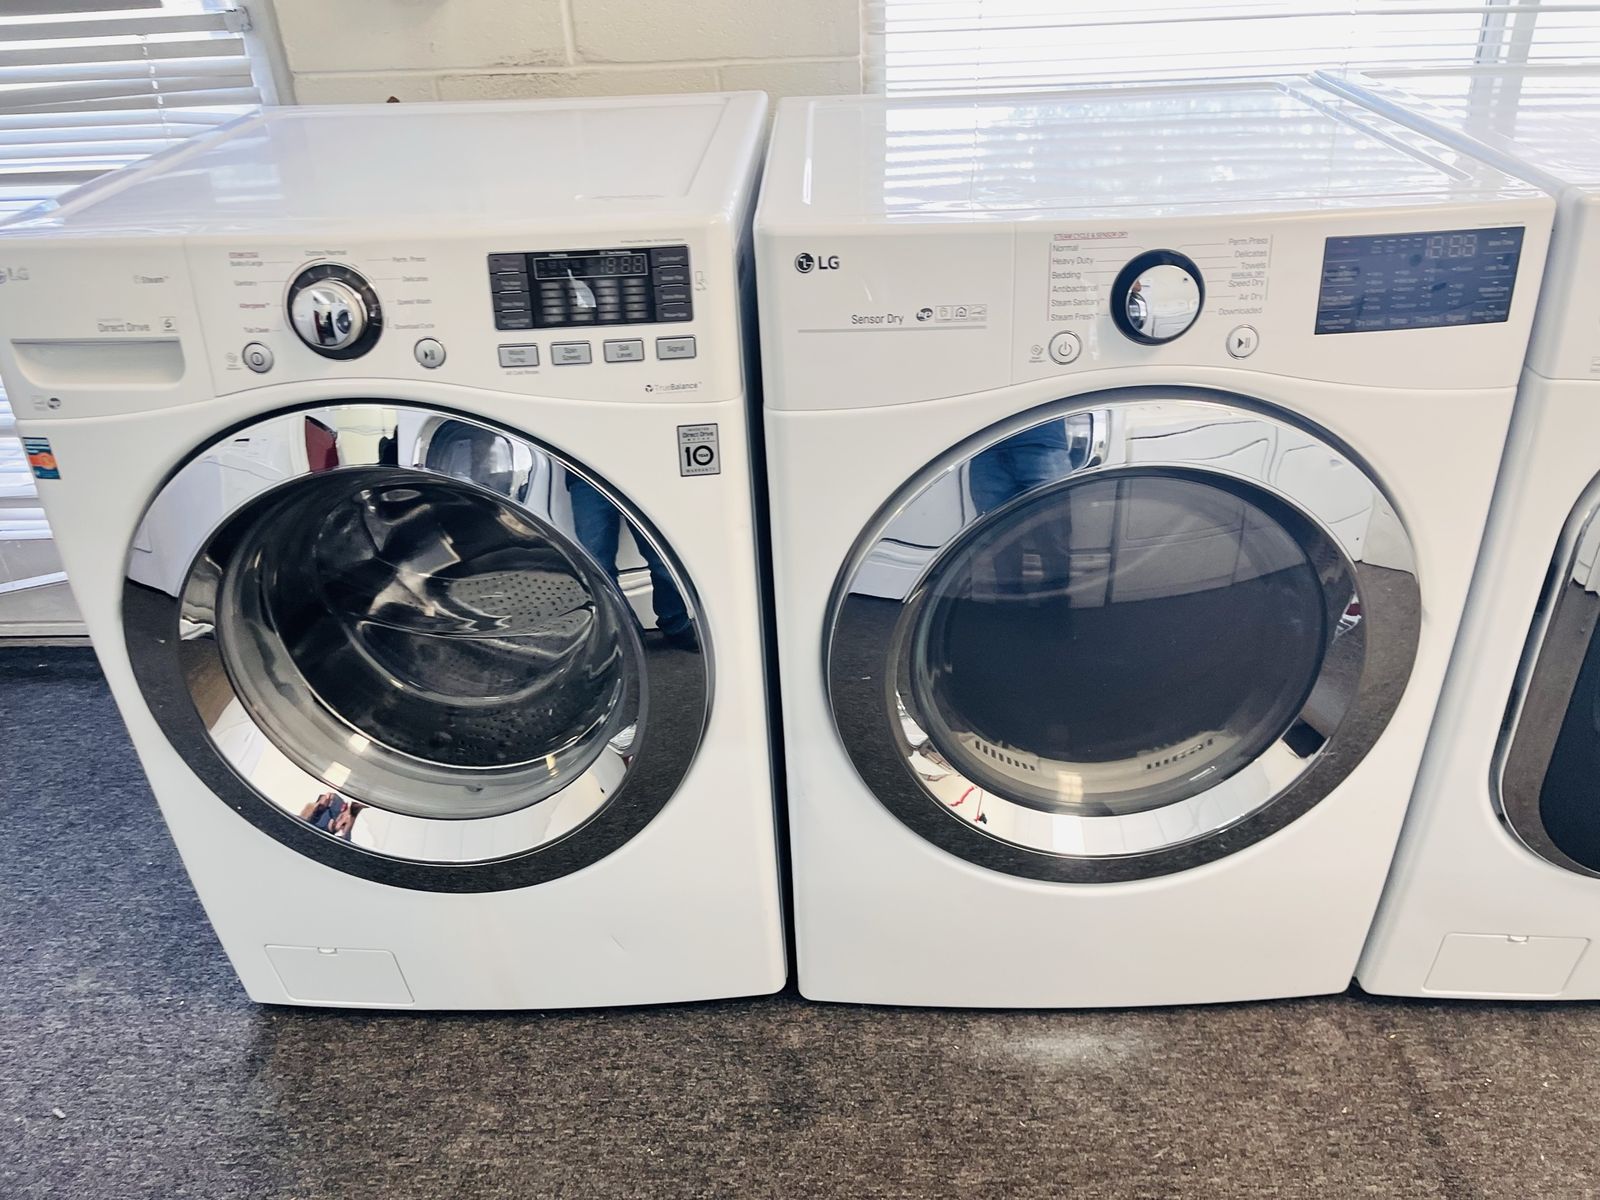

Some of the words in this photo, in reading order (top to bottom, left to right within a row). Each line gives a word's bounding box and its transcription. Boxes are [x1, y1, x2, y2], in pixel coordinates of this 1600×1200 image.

[1052, 244, 1079, 252] Normal
[1234, 249, 1267, 258] Delicates
[818, 255, 840, 270] LG
[1052, 257, 1075, 265] Heavy
[1076, 256, 1094, 266] Duty
[1240, 262, 1266, 270] Towels
[1052, 271, 1081, 280] Bedding
[1228, 279, 1250, 288] Speed
[1251, 278, 1264, 287] Dry
[1052, 285, 1099, 293] Antibacterial
[1250, 292, 1263, 301] Dry
[1051, 299, 1073, 307] Steam
[1218, 306, 1263, 315] Downloaded
[851, 314, 885, 325] Sensor
[887, 313, 904, 326] Dry
[1051, 313, 1073, 321] Steam
[685, 445, 714, 467] 10
